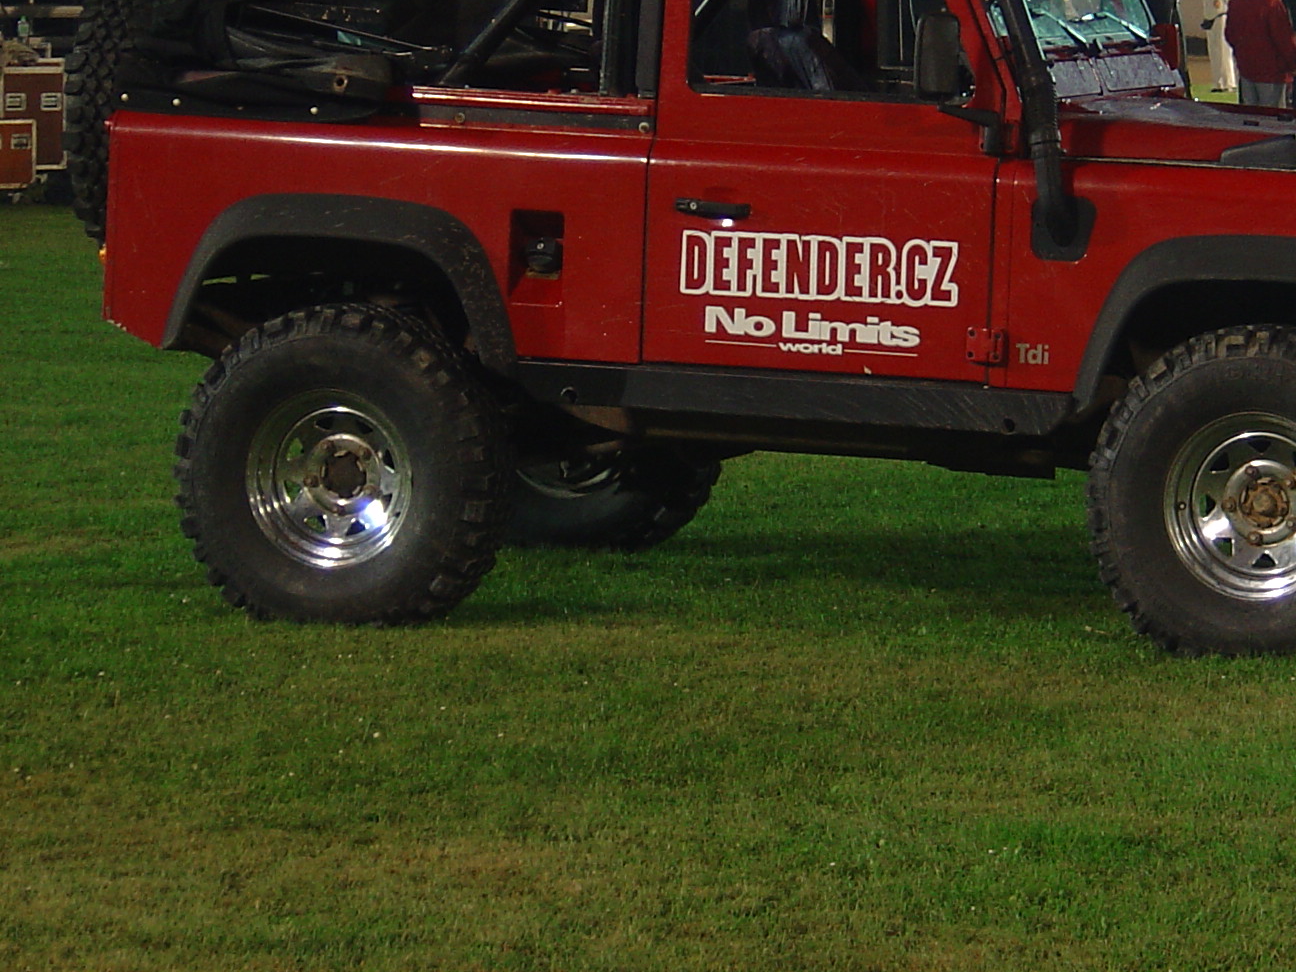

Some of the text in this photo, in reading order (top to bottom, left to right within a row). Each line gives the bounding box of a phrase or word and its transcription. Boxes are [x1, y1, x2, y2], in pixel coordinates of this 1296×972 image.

[679, 229, 959, 307] DEFENDER.CZ
[705, 305, 921, 347] No Limits
[778, 340, 843, 356] world
[1015, 342, 1049, 366] Tdi
